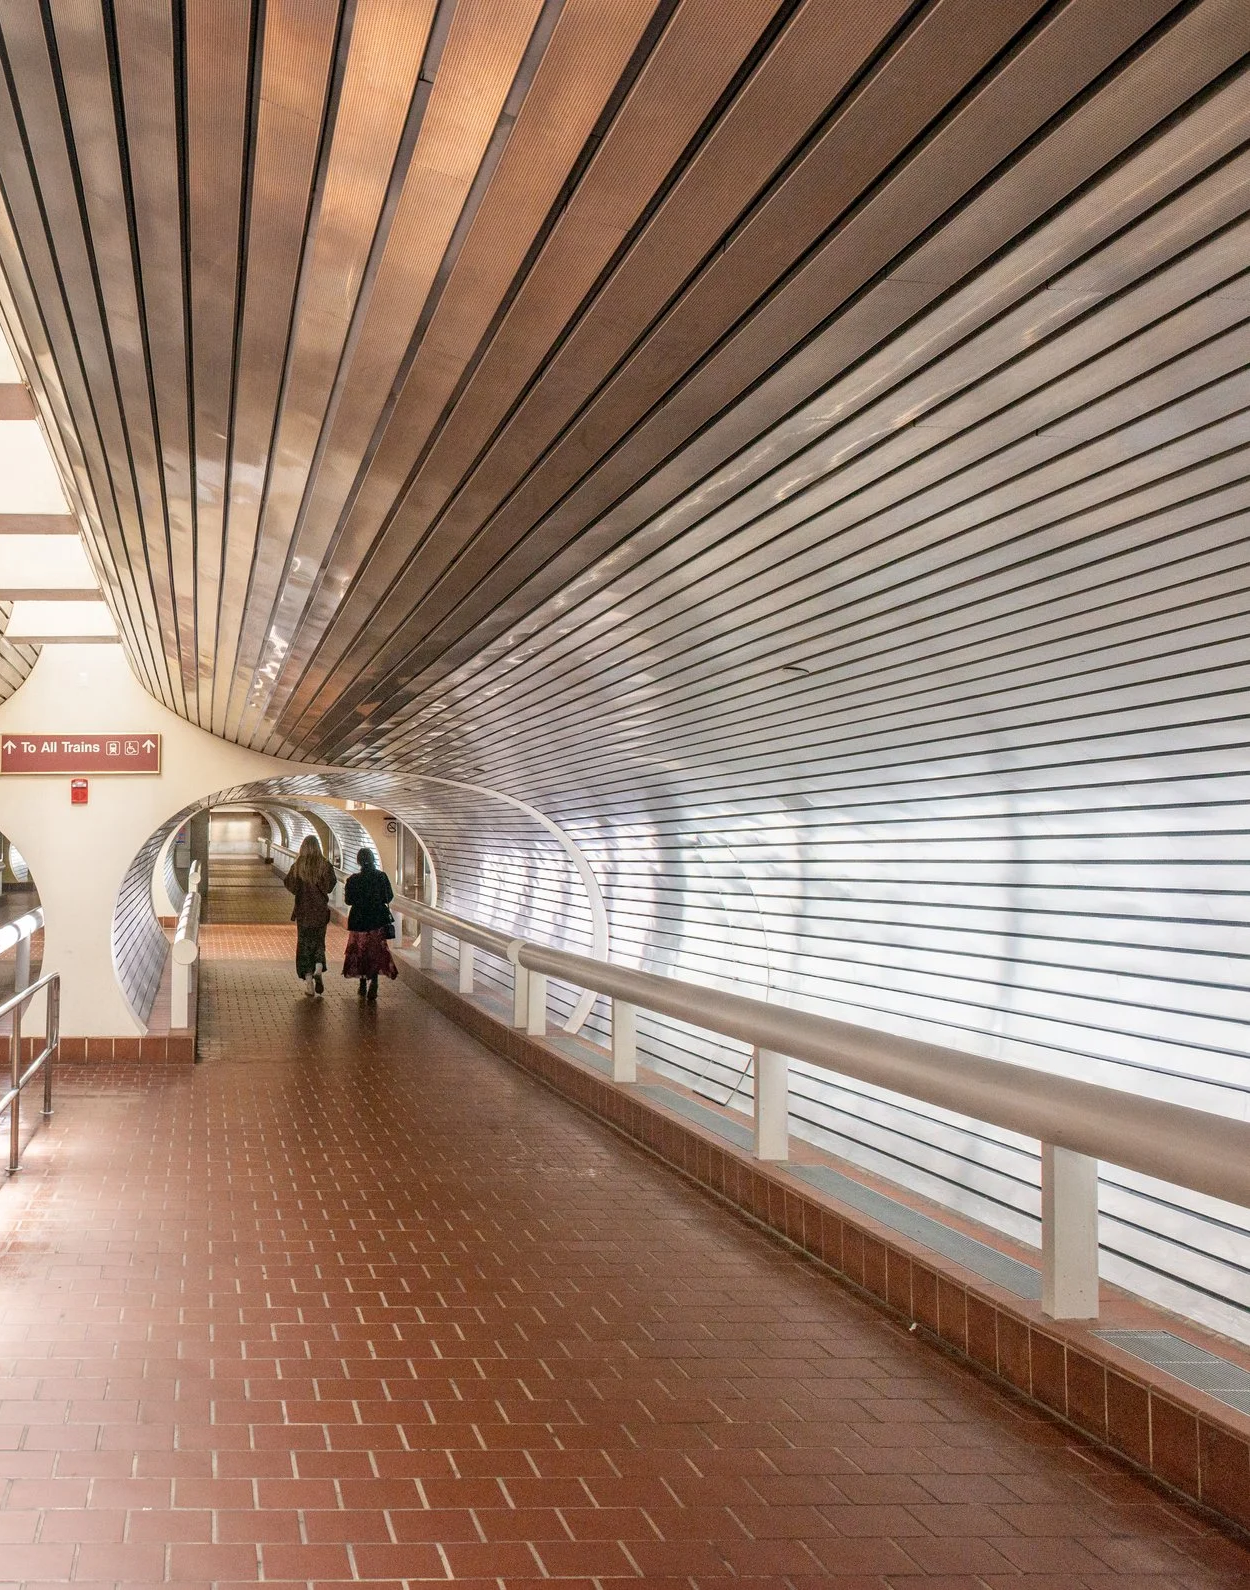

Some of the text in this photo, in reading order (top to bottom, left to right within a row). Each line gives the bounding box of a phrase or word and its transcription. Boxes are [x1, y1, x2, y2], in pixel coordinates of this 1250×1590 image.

[21, 741, 100, 753] To All Trains
